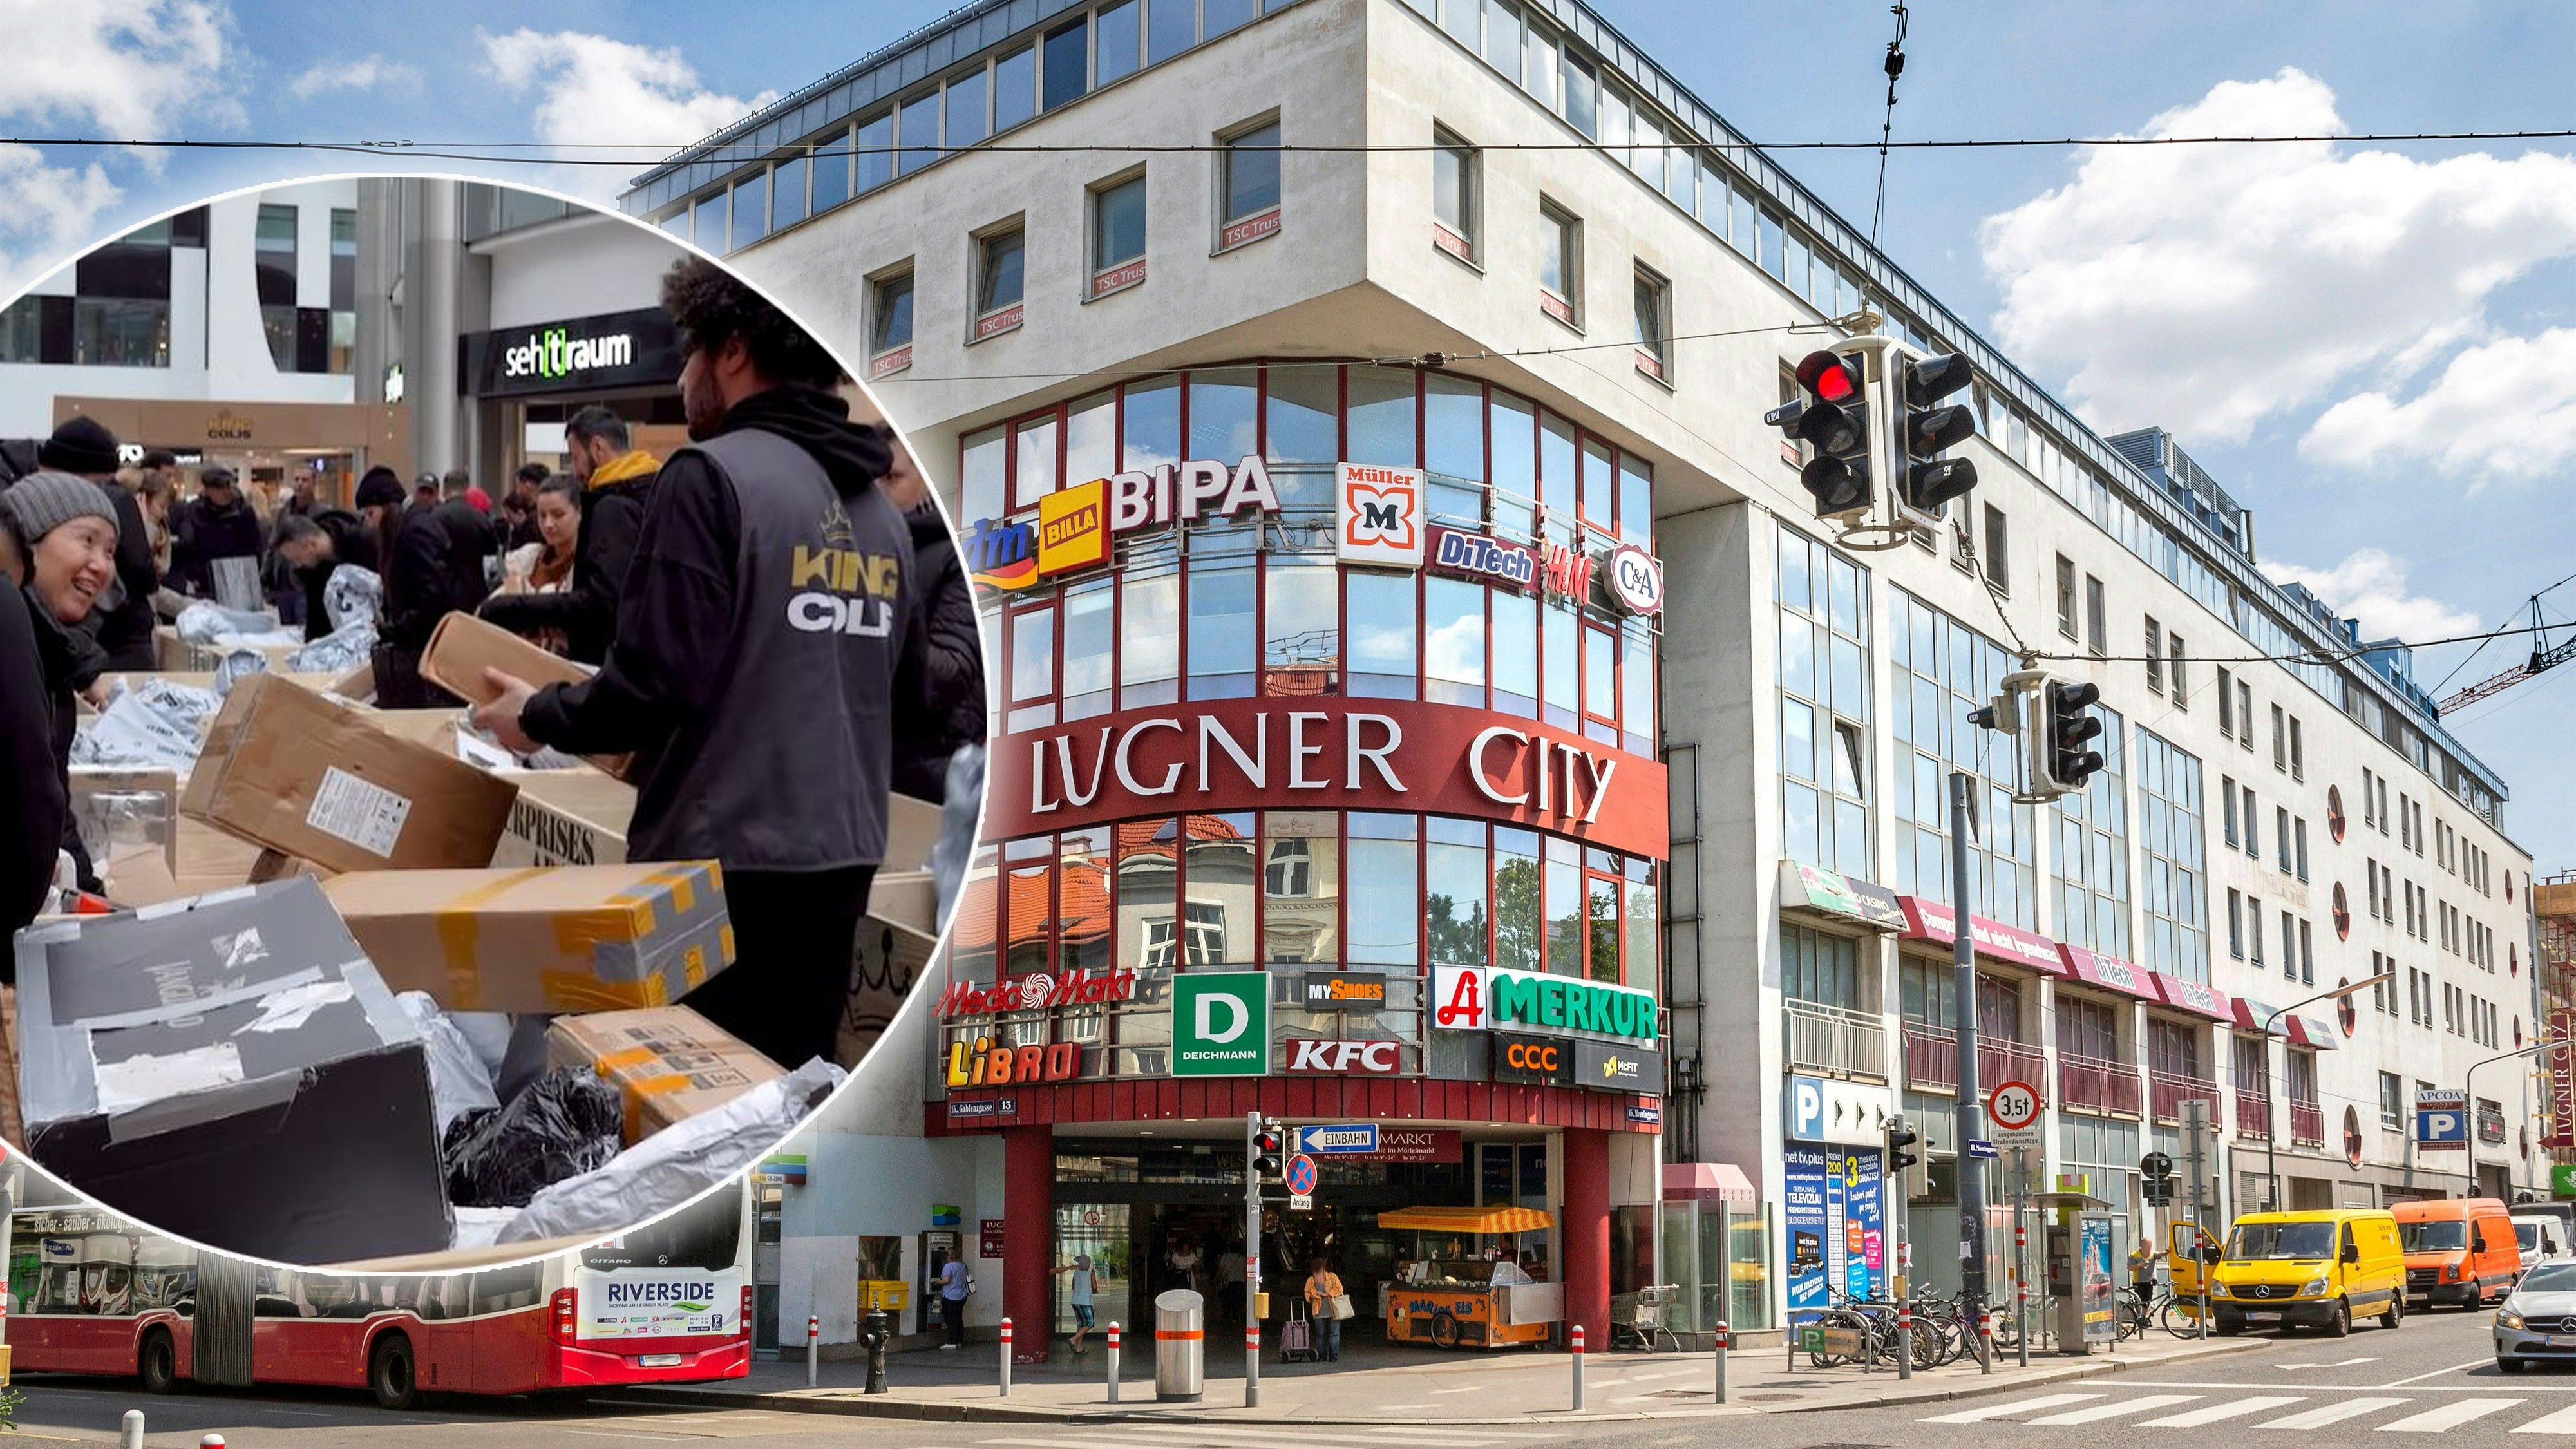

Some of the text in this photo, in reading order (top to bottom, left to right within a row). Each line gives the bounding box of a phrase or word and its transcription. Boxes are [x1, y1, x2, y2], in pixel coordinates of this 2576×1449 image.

[1226, 226, 1248, 243] TSC
[1446, 234, 1469, 258] Trust
[1097, 267, 1146, 290] TSC Trus
[981, 310, 1023, 334] TSC Trus
[1550, 299, 1570, 322] Trust
[874, 352, 913, 373] TSC Trus
[1347, 467, 1414, 486] Müller
[1111, 455, 1282, 533] BIPA
[1048, 510, 1095, 545] BILLA
[1363, 502, 1398, 531] M
[964, 518, 1028, 572] dm
[1440, 533, 1533, 583] DiTech
[791, 545, 898, 600] KING
[1620, 560, 1656, 600] C&A
[1032, 711, 1616, 824] LUGNER CITY
[1862, 895, 1889, 911] CASINO
[2092, 954, 2136, 989] DiTech
[931, 967, 1141, 1018] Media Markt
[2181, 981, 2217, 1012] DiTech
[1195, 992, 1249, 1043] D
[1493, 973, 1659, 1040] MERKUR
[1182, 1051, 1256, 1061] DEICHMANN
[1290, 1040, 1397, 1071] KFC
[1508, 1043, 1557, 1072] CCC
[1618, 1061, 1638, 1072] McFIT
[2552, 1024, 2573, 1137] LUGNER CTY
[1001, 1100, 1012, 1110] 13
[2000, 1094, 2029, 1117] 3,5t
[2418, 1091, 2461, 1101] APCOA
[959, 1104, 992, 1114] Gablenzgasse
[1796, 1084, 1819, 1134] P
[2429, 1114, 2456, 1139] P
[1325, 1132, 1368, 1145] EINBAHN
[1217, 1154, 1245, 1167] WES
[1785, 1152, 1797, 1163] net
[1828, 1162, 1842, 1173] 200
[1858, 1154, 1877, 1164] meseca
[1858, 1162, 1878, 1173] pretplate
[1846, 1156, 1858, 1188] 3
[1858, 1172, 1879, 1184] GRATIS!
[1293, 1198, 1310, 1208] Anfang
[34, 1216, 58, 1233] sicher
[64, 1215, 91, 1232] sauber
[609, 1282, 714, 1302] RIVERSIDE
[1454, 1300, 1473, 1315] EIS
[1804, 1331, 1821, 1349] P
